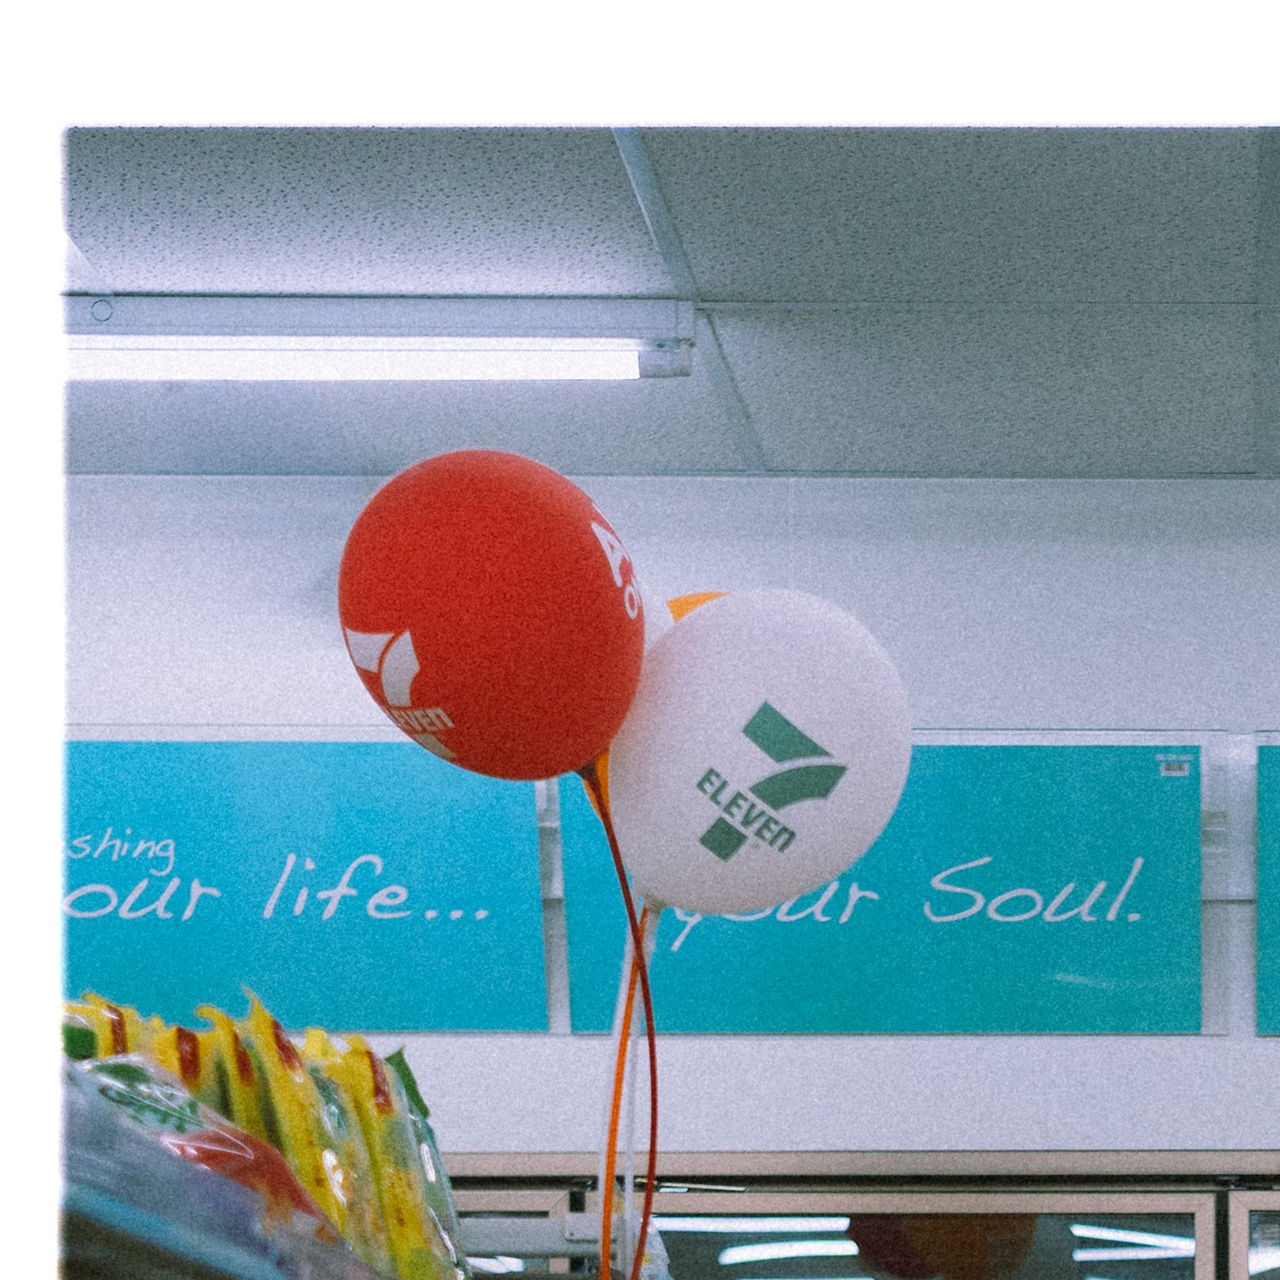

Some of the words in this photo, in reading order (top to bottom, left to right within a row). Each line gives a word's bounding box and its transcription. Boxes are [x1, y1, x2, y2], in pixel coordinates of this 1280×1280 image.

[68, 828, 174, 875] shing
[63, 881, 222, 922] our
[261, 855, 490, 922] life...
[924, 856, 1143, 923] Soul.
